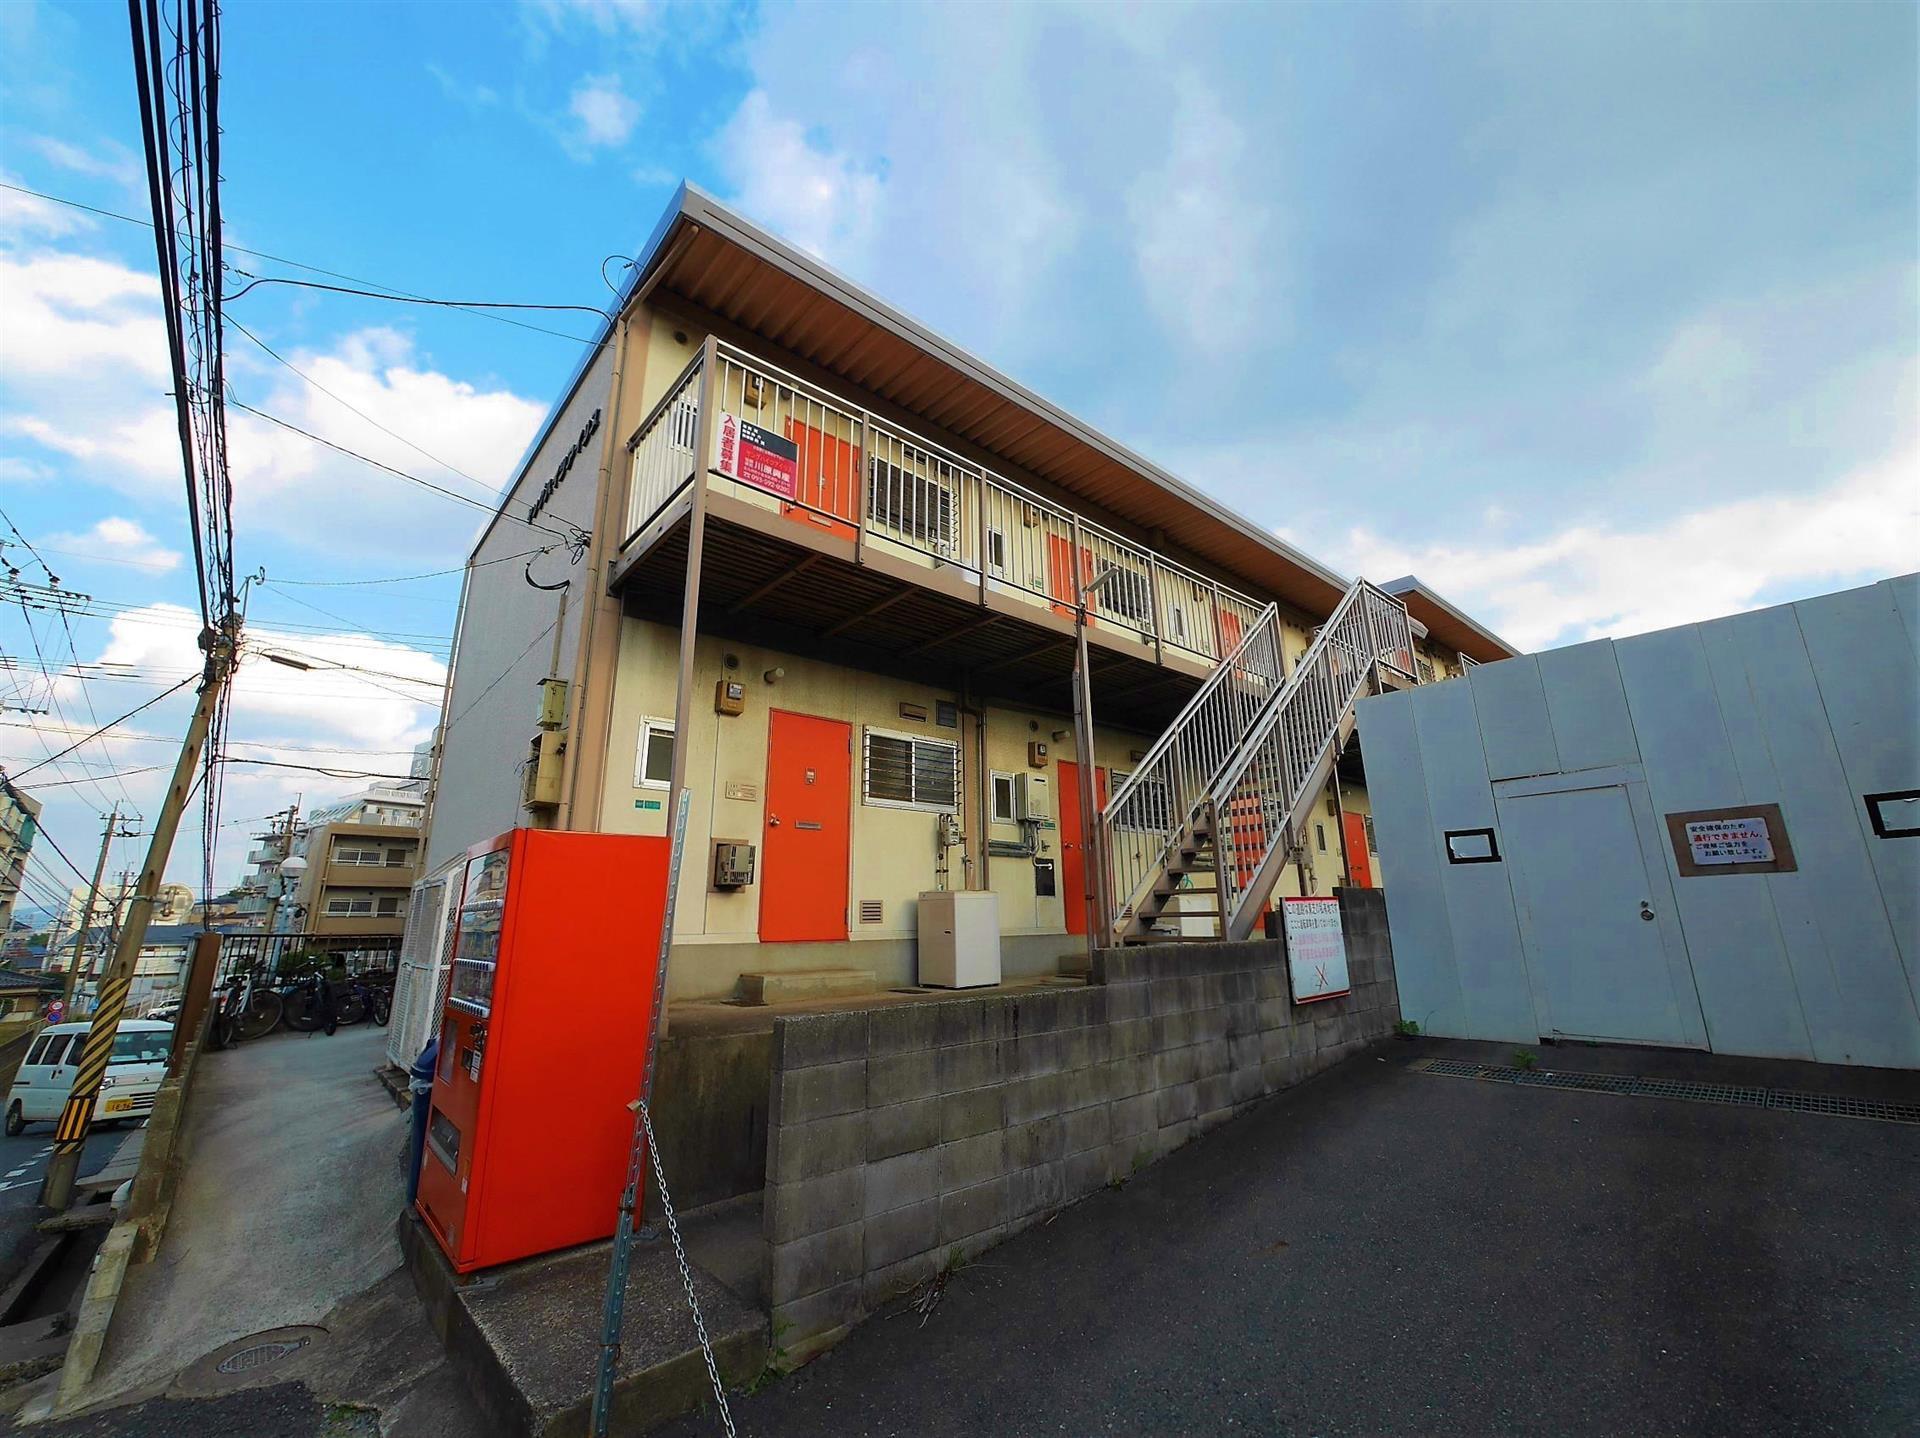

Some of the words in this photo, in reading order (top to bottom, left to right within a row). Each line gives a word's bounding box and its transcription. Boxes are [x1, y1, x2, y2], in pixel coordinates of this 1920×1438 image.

[720, 414, 736, 474] 入居者募集
[1689, 823, 1746, 833] 安全確保のため
